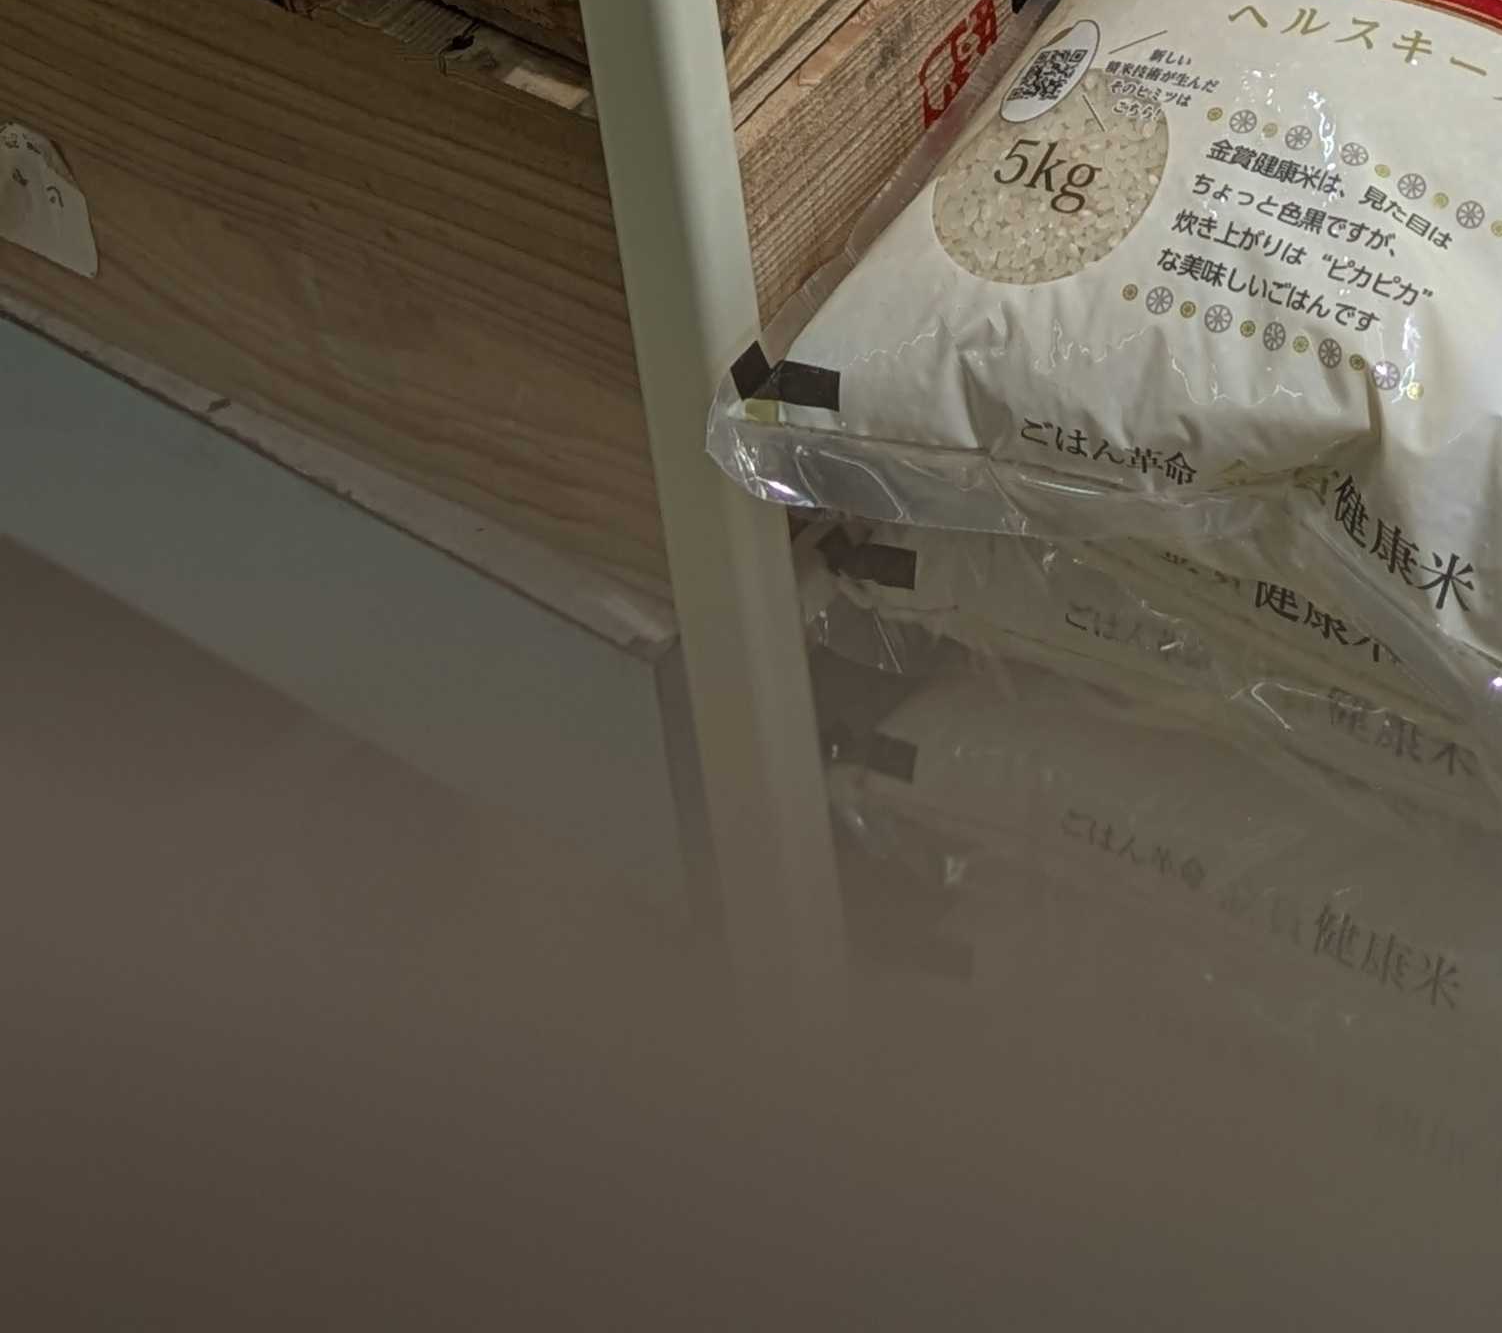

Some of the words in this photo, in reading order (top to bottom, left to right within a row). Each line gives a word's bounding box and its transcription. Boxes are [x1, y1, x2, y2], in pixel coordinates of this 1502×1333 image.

[1149, 48, 1192, 66] 新しい
[1113, 100, 1162, 120] こちら!
[993, 138, 1102, 214] 5kg
[1192, 173, 1397, 258] ちょっと色黒ですが、
[1157, 248, 1381, 333] な美味しいごはんです
[1022, 418, 1197, 485] ごはん革命
